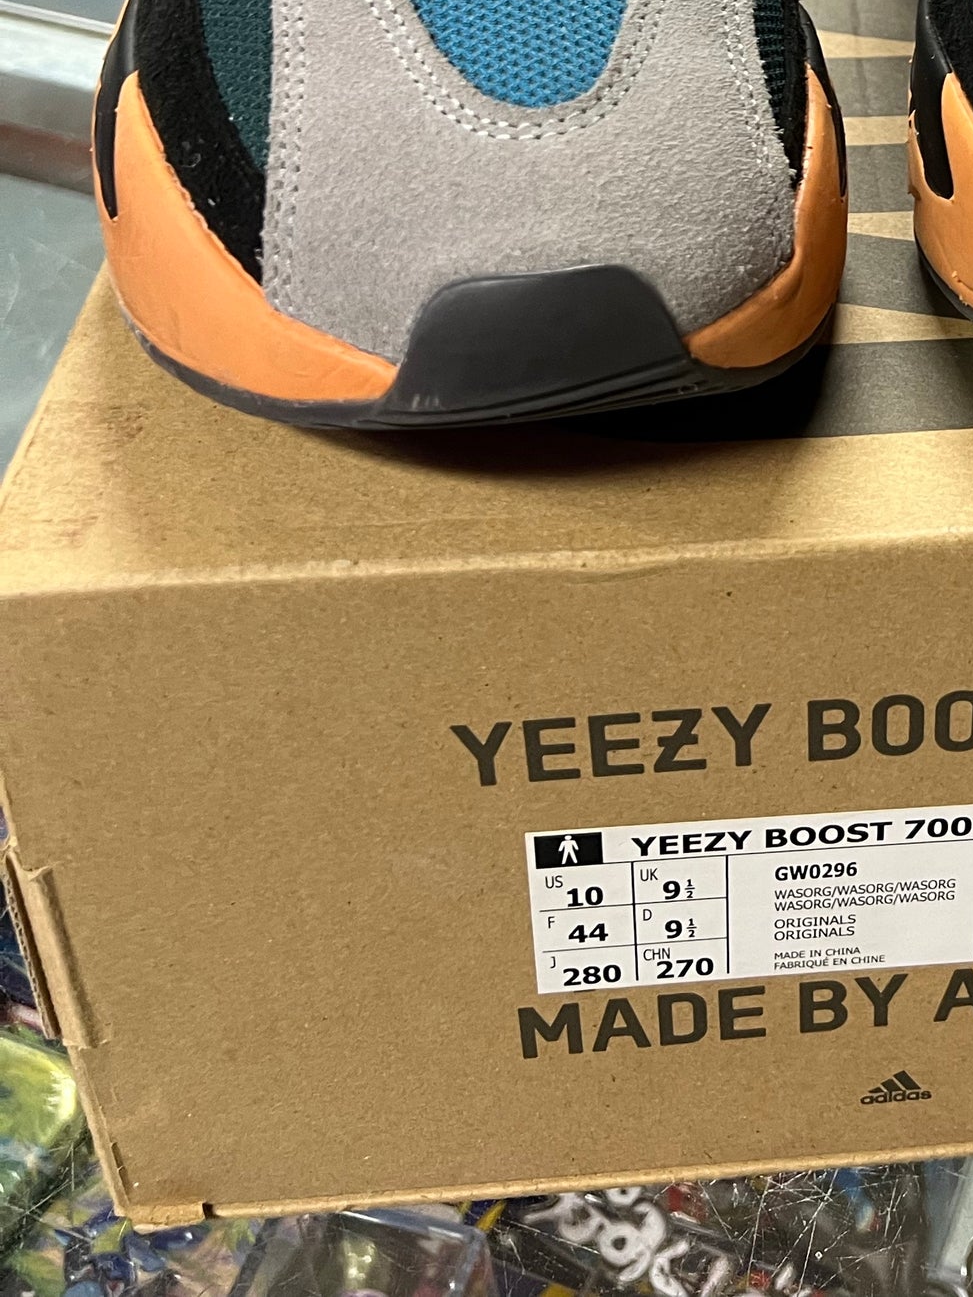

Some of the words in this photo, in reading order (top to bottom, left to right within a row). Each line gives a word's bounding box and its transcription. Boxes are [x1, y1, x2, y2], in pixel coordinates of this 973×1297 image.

[451, 703, 773, 787] YEEZY
[631, 830, 752, 857] YEEZY
[765, 821, 893, 848] BOOST
[904, 816, 973, 840] 700
[640, 868, 658, 882] UK
[774, 862, 858, 881] GW0296
[545, 875, 564, 889] US
[566, 886, 604, 907] 10
[774, 878, 957, 900] WASORG/WASORG/WASORG
[774, 890, 956, 912] WASORG/WASORG/WASORG
[642, 908, 653, 921] D
[774, 914, 857, 929] ORIGINALS
[547, 916, 556, 929] F
[568, 923, 609, 943] 44
[774, 926, 855, 941] ORIGINALS
[642, 947, 671, 961] CHN
[774, 950, 806, 960] MADE
[809, 949, 822, 958] IN
[825, 946, 861, 957] CHINA
[774, 957, 830, 970] FABRIQUÉ
[833, 957, 848, 966] EN
[851, 954, 886, 964] CHINE
[549, 955, 557, 969] J
[562, 964, 622, 986] 280
[656, 957, 714, 979] 270
[517, 986, 767, 1060] MADE
[800, 973, 911, 1033] BY
